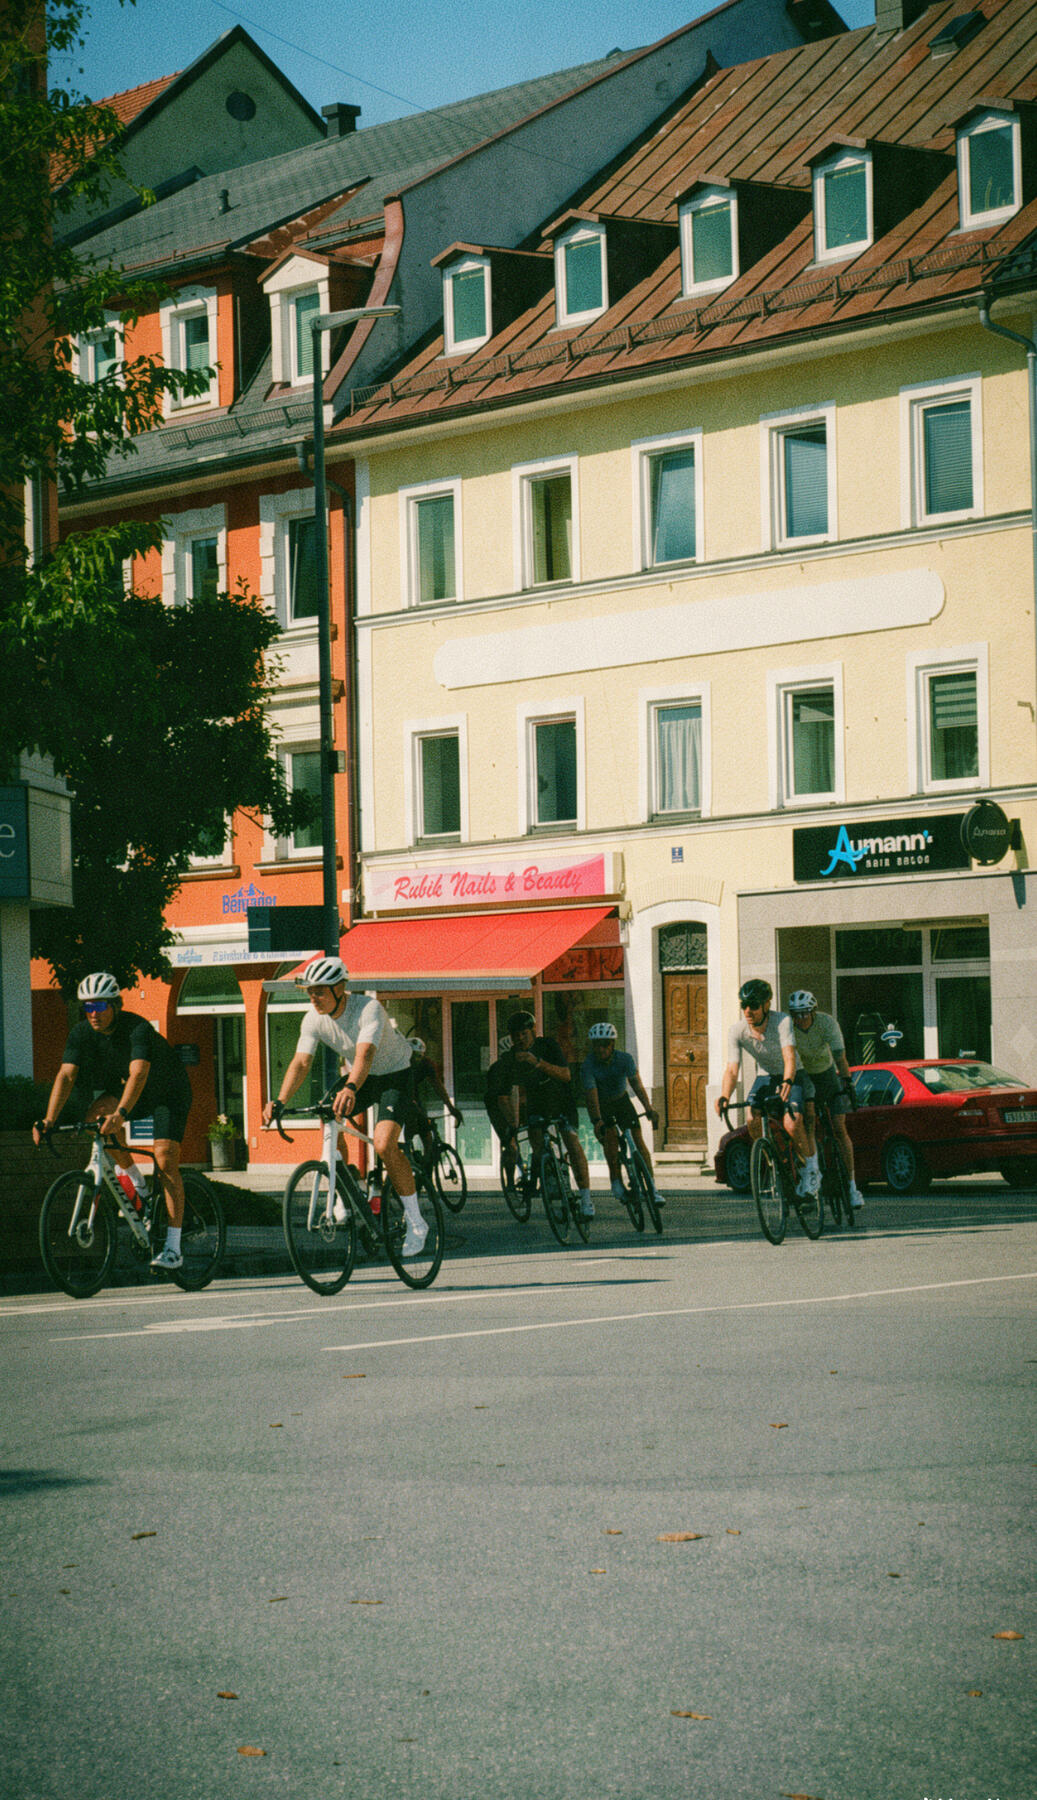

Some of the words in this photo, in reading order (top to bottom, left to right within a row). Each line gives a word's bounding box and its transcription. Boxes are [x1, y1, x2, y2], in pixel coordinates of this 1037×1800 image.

[393, 873, 443, 901] Rubik
[450, 871, 497, 897] Nails
[504, 871, 516, 893] &
[522, 865, 583, 893] Beauty
